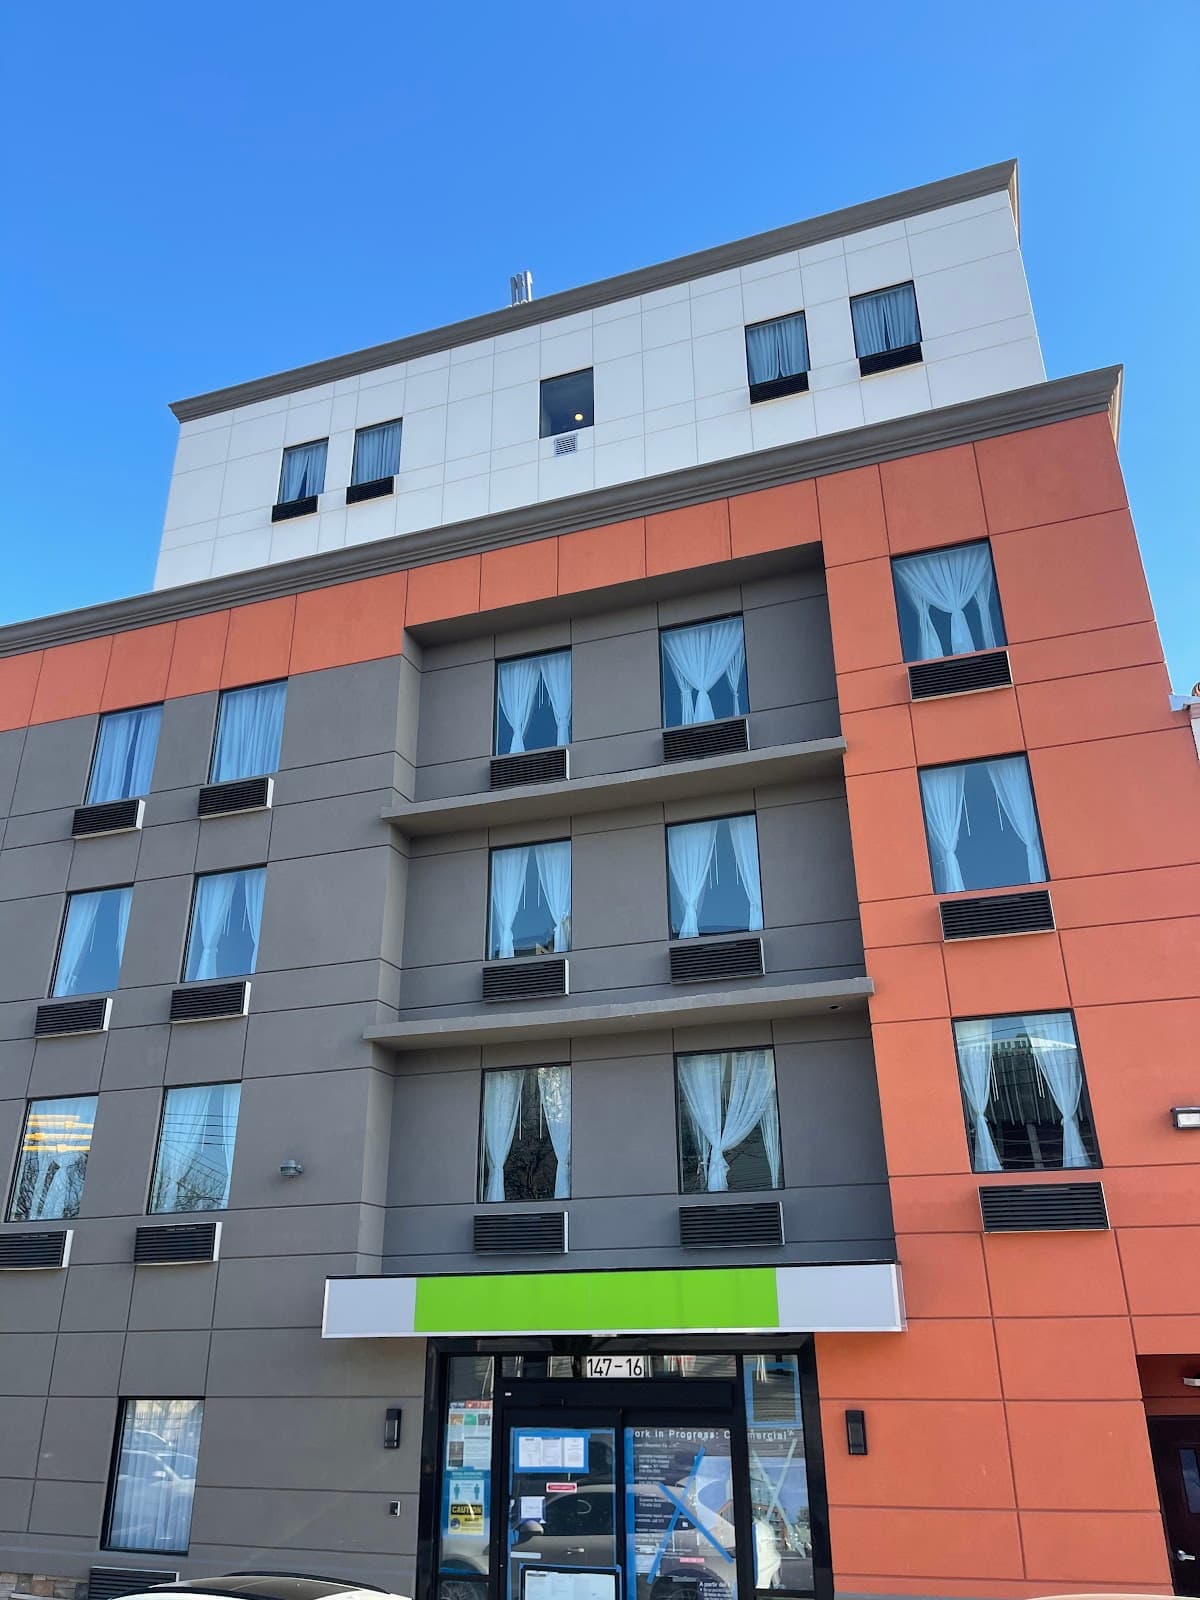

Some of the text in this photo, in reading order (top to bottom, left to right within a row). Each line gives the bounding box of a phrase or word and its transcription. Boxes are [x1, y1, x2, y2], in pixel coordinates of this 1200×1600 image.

[587, 1358, 642, 1377] 147-16
[633, 1429, 651, 1439] ork
[654, 1429, 664, 1439] in
[668, 1429, 719, 1441] Progress:
